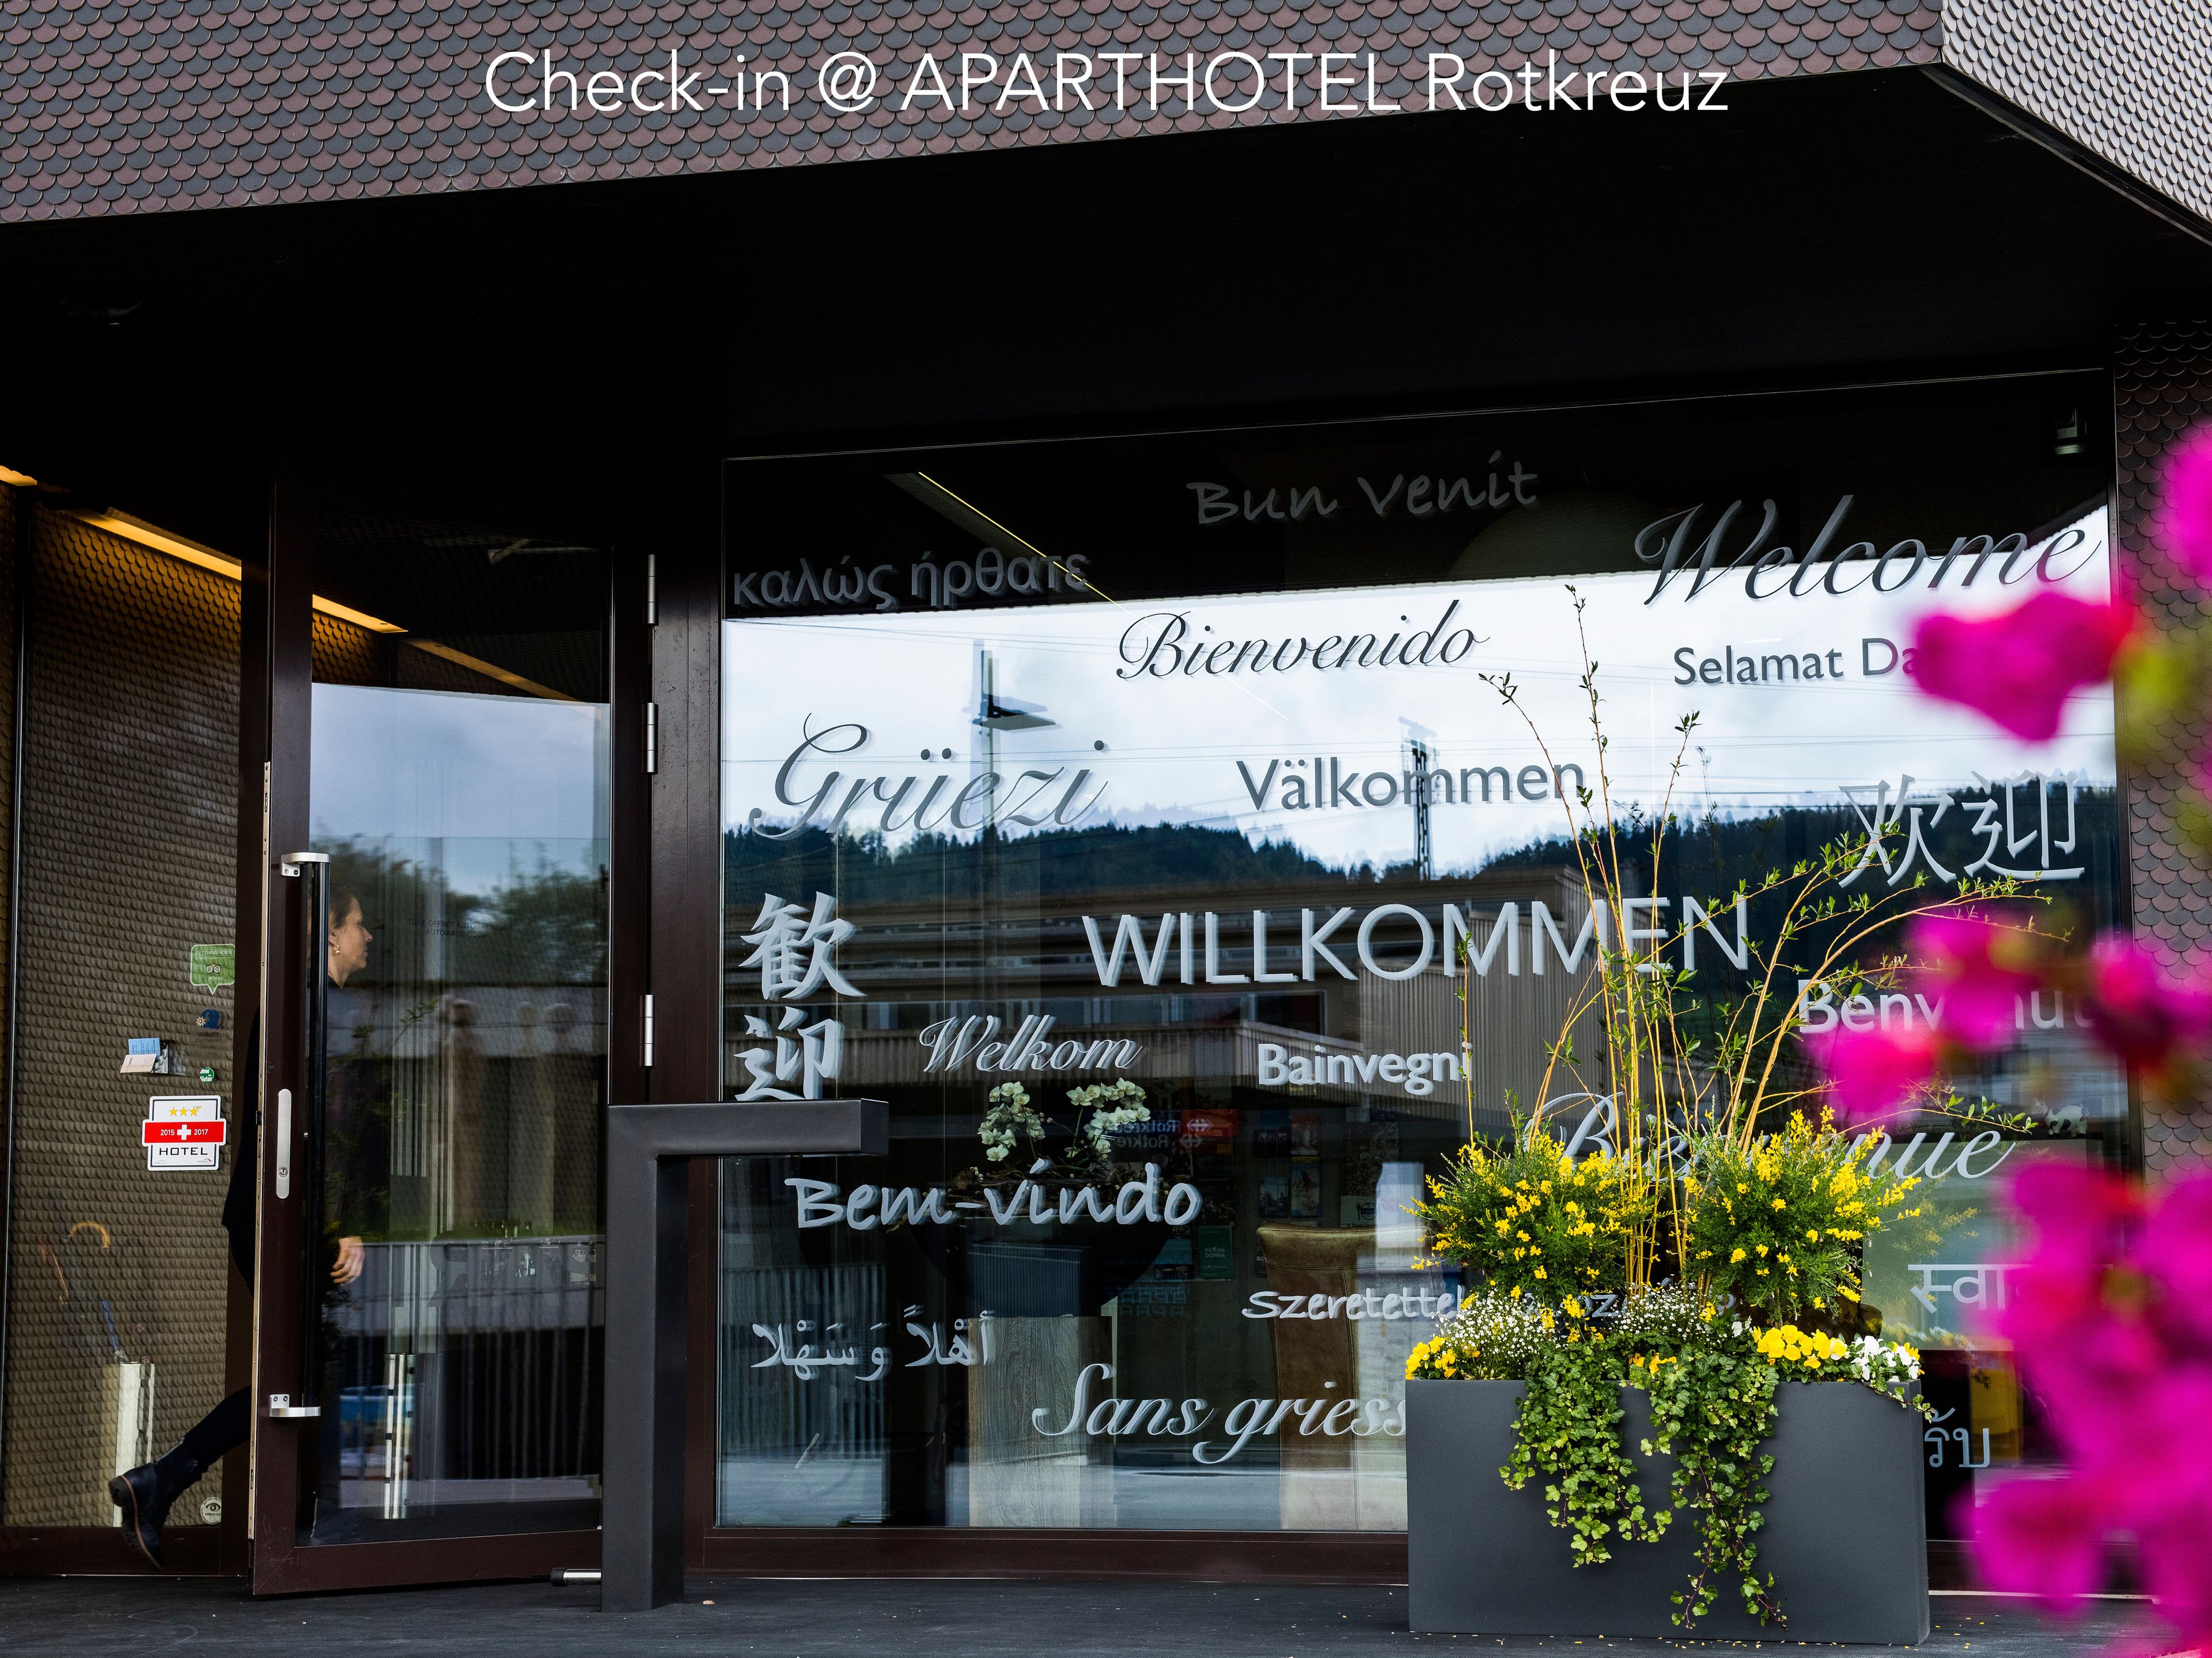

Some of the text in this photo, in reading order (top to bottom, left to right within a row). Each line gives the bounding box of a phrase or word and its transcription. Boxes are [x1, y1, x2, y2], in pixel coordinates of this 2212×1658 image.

[1185, 481, 1338, 525] Bun
[733, 555, 895, 610] καλώς
[1634, 494, 2103, 606] Welcome
[1116, 598, 1491, 680] Bienvenido
[1673, 645, 1843, 685] Selamat
[748, 712, 1109, 840] Grüezi
[1236, 756, 1585, 811] Välkommen
[1838, 769, 2085, 888] 欢迎
[1081, 896, 1748, 987] WILLKOMMEN
[920, 1014, 1145, 1073] Welkom
[1258, 1041, 1472, 1096] Bainvegni
[159, 1147, 208, 1155] HOTEL
[784, 1157, 1202, 1231] Bem-vindo
[1032, 1363, 1215, 1437] Sans
